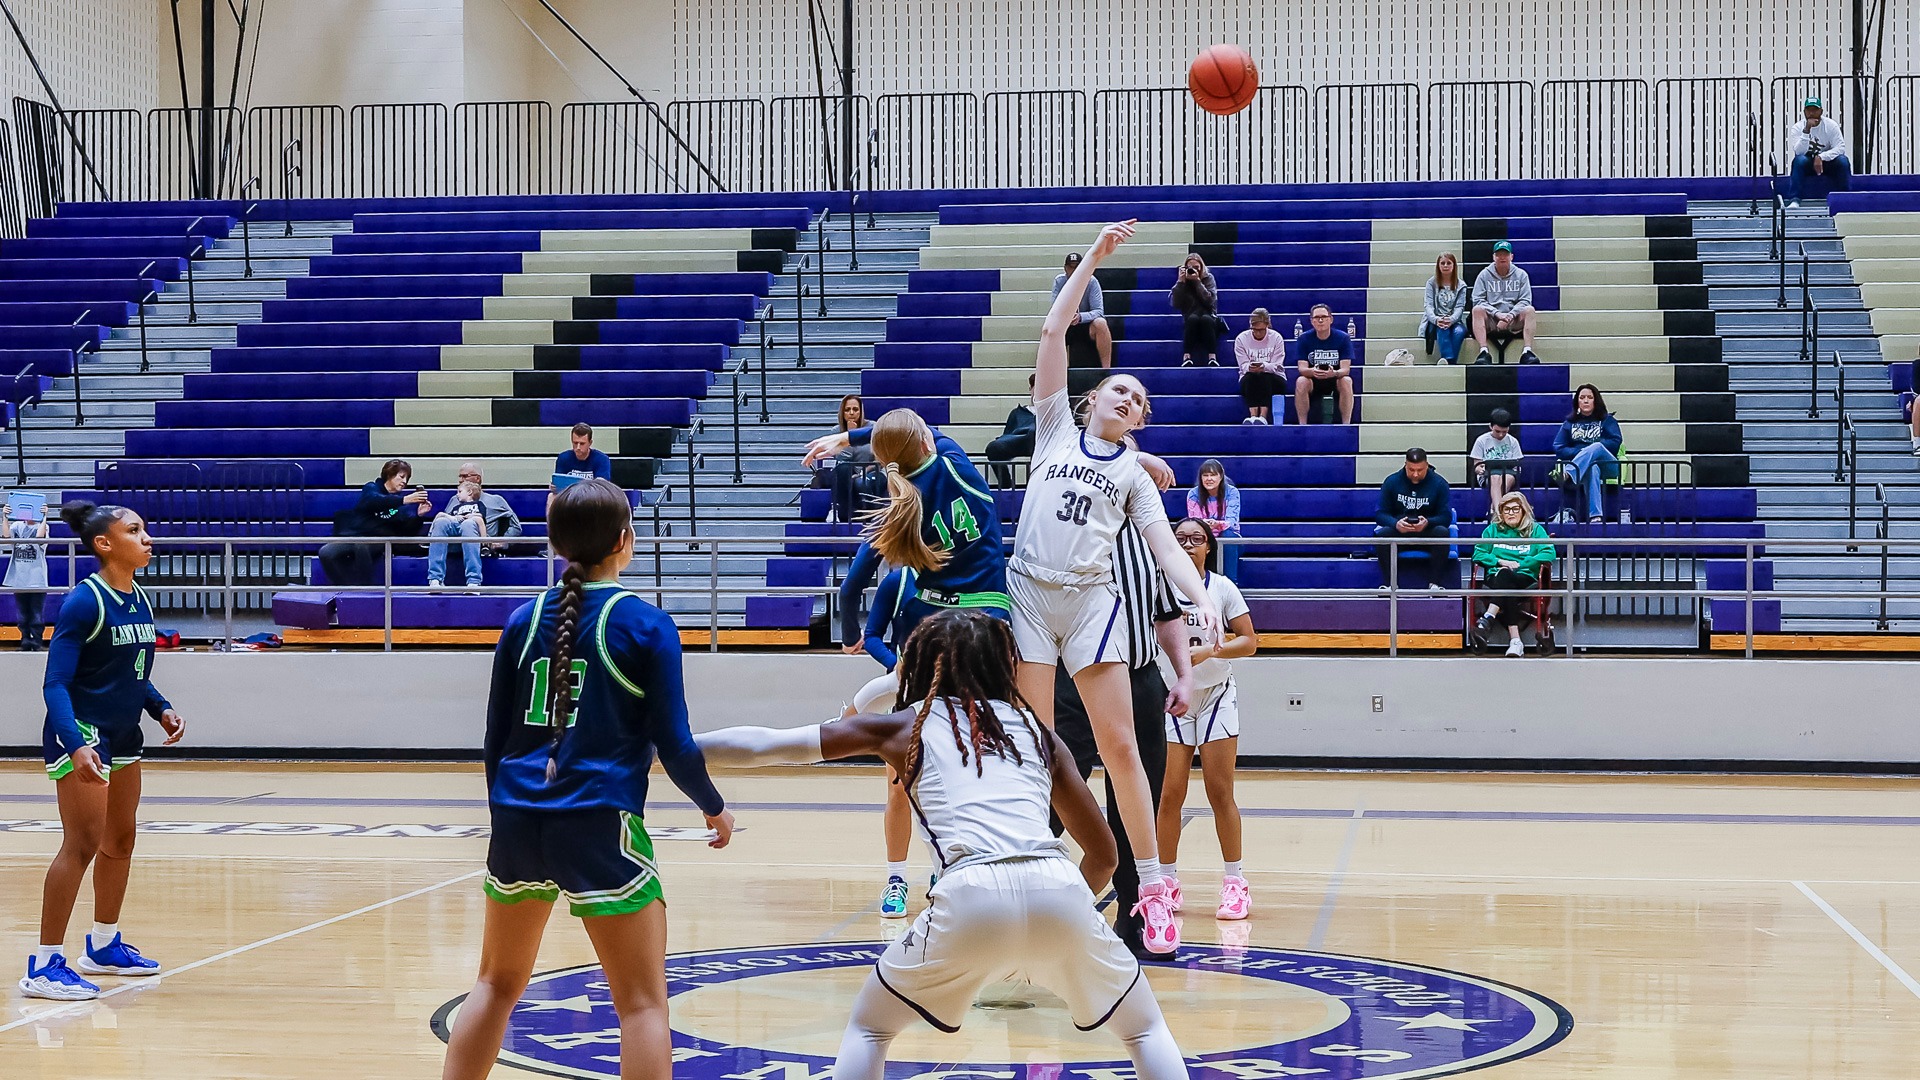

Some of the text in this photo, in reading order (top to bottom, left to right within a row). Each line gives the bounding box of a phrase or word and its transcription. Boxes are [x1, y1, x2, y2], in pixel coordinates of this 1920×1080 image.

[1487, 280, 1520, 292] NIKE
[1045, 464, 1119, 507] RANGERS
[932, 496, 981, 551] 14
[1056, 490, 1092, 526] 30
[111, 623, 136, 646] LADY
[134, 648, 146, 680] 4
[524, 657, 588, 728] 12
[1279, 965, 1465, 1007] SCHOOL
